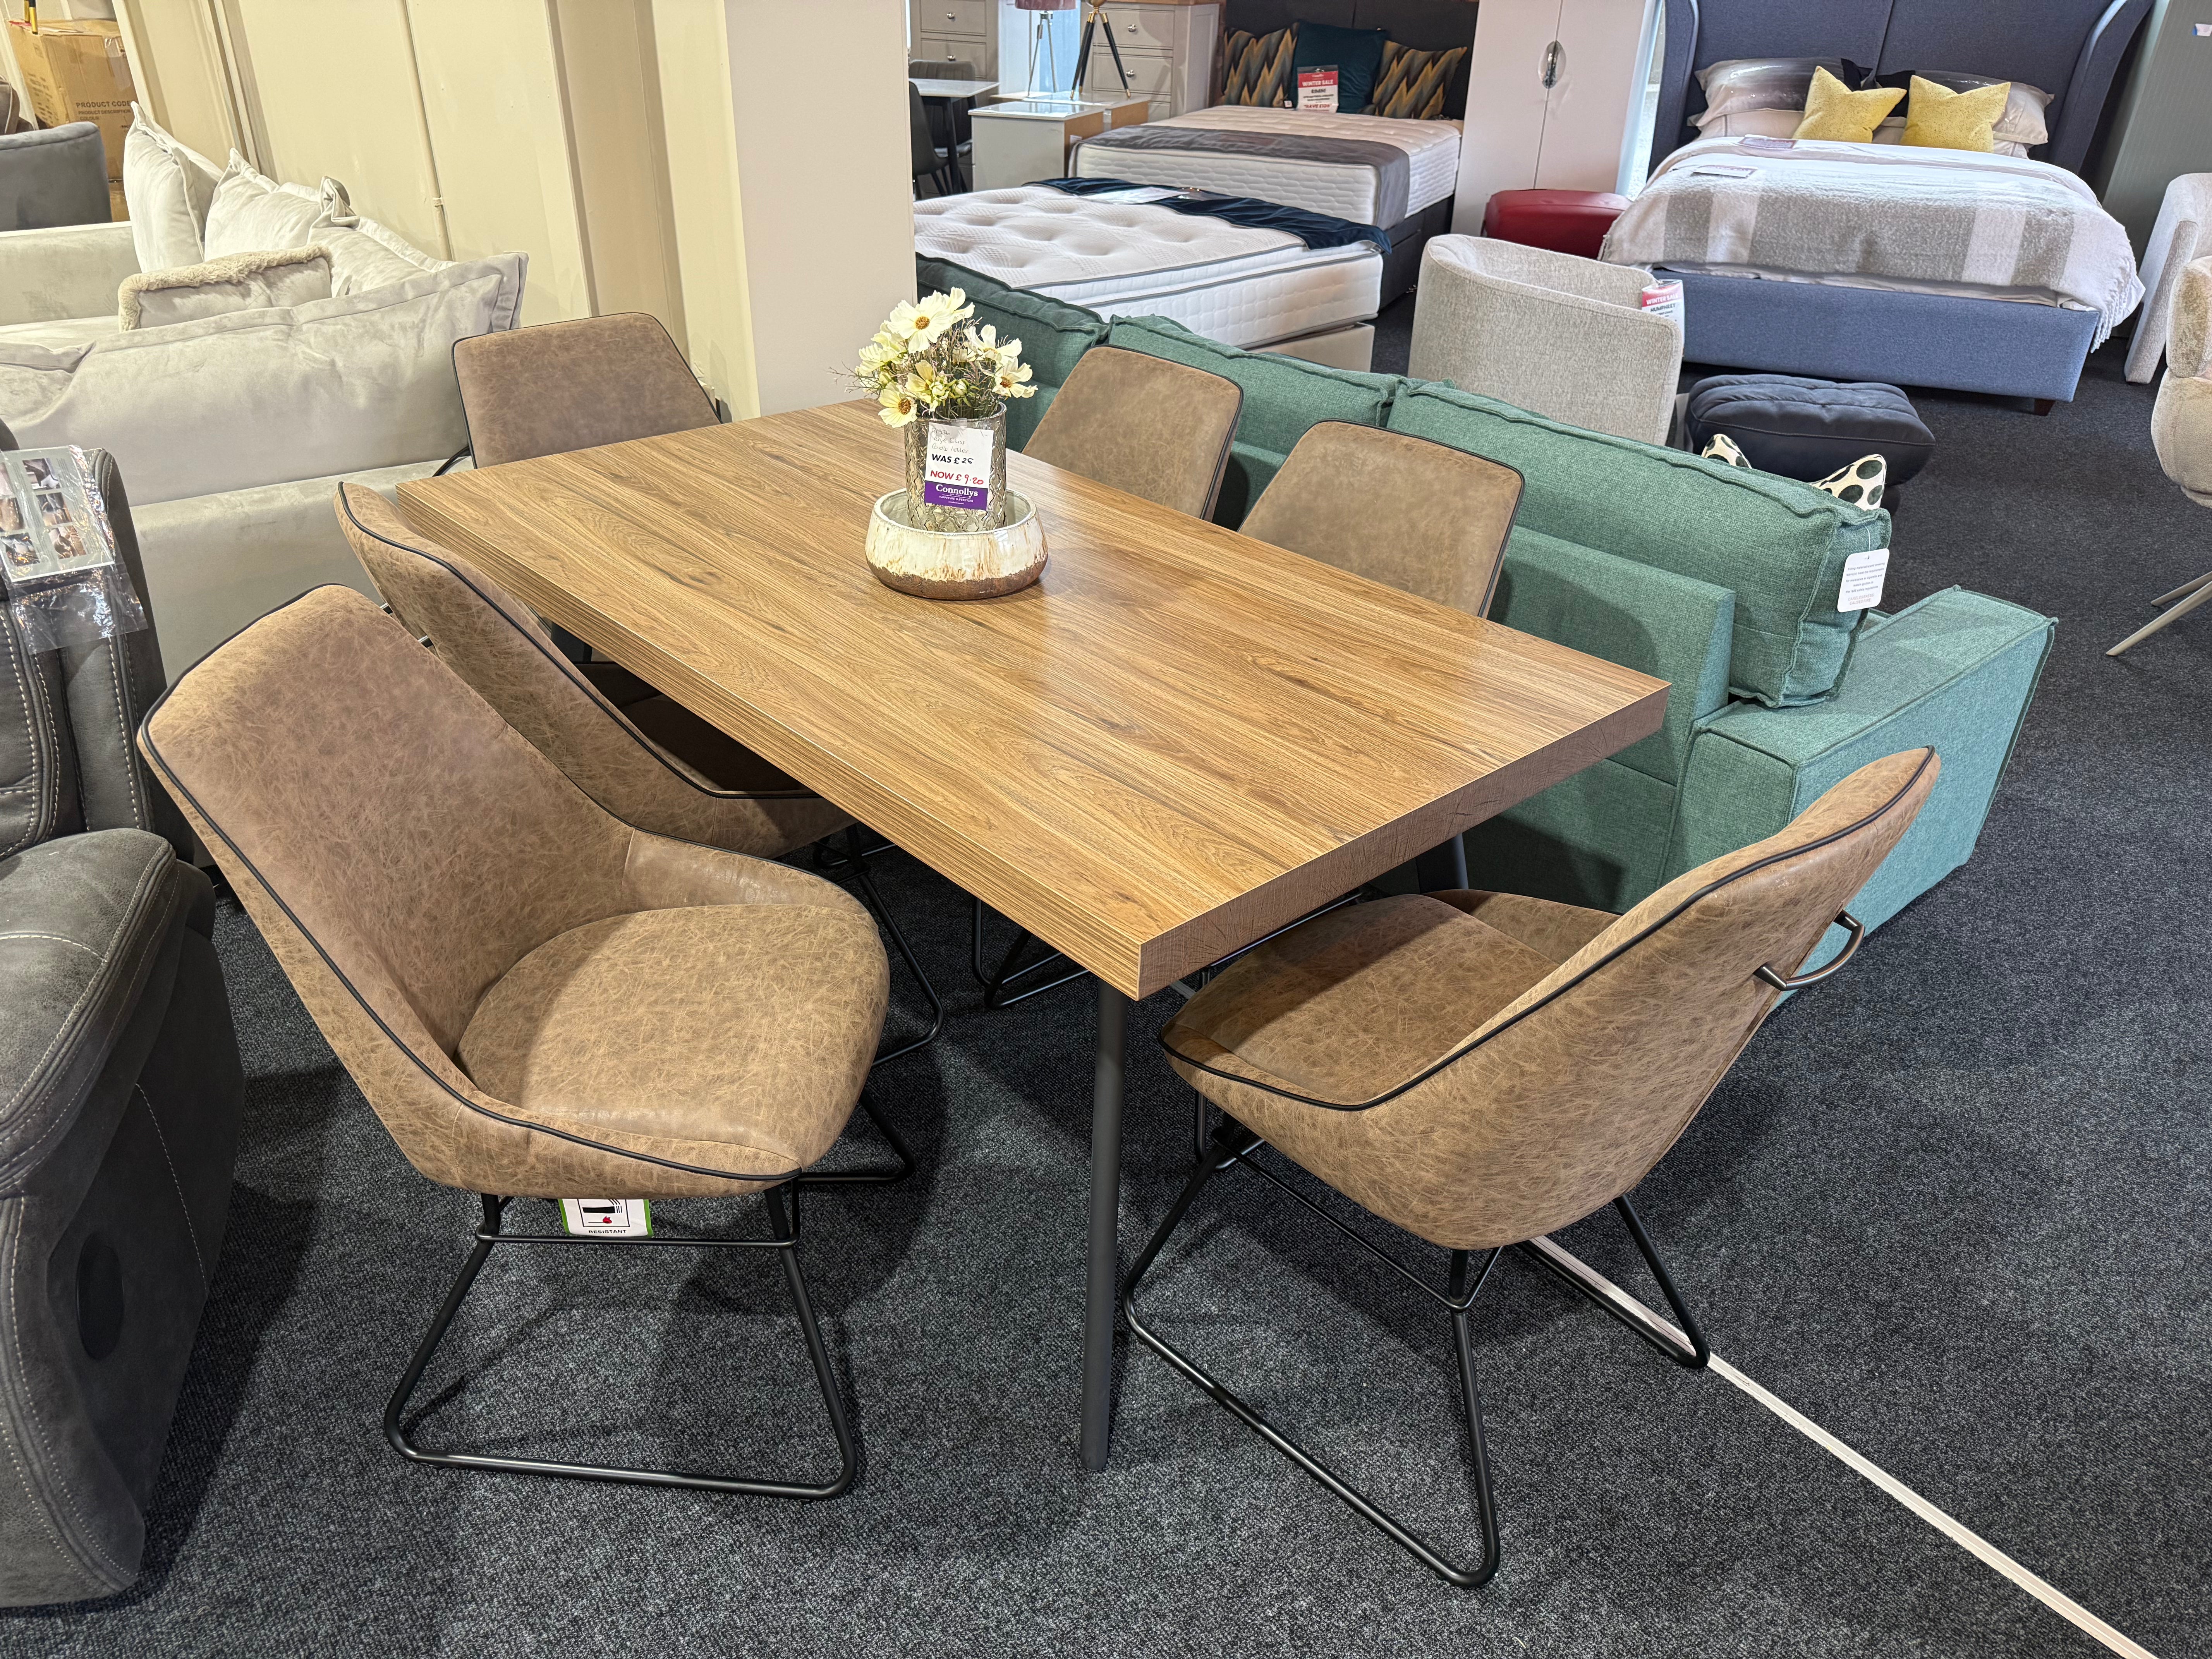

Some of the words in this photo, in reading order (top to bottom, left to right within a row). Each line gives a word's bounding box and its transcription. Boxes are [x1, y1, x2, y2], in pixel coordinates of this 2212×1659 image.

[1646, 296, 1666, 305] WINTER
[932, 453, 952, 463] WAS
[930, 470, 954, 480] NOW
[936, 484, 978, 498] Connollys
